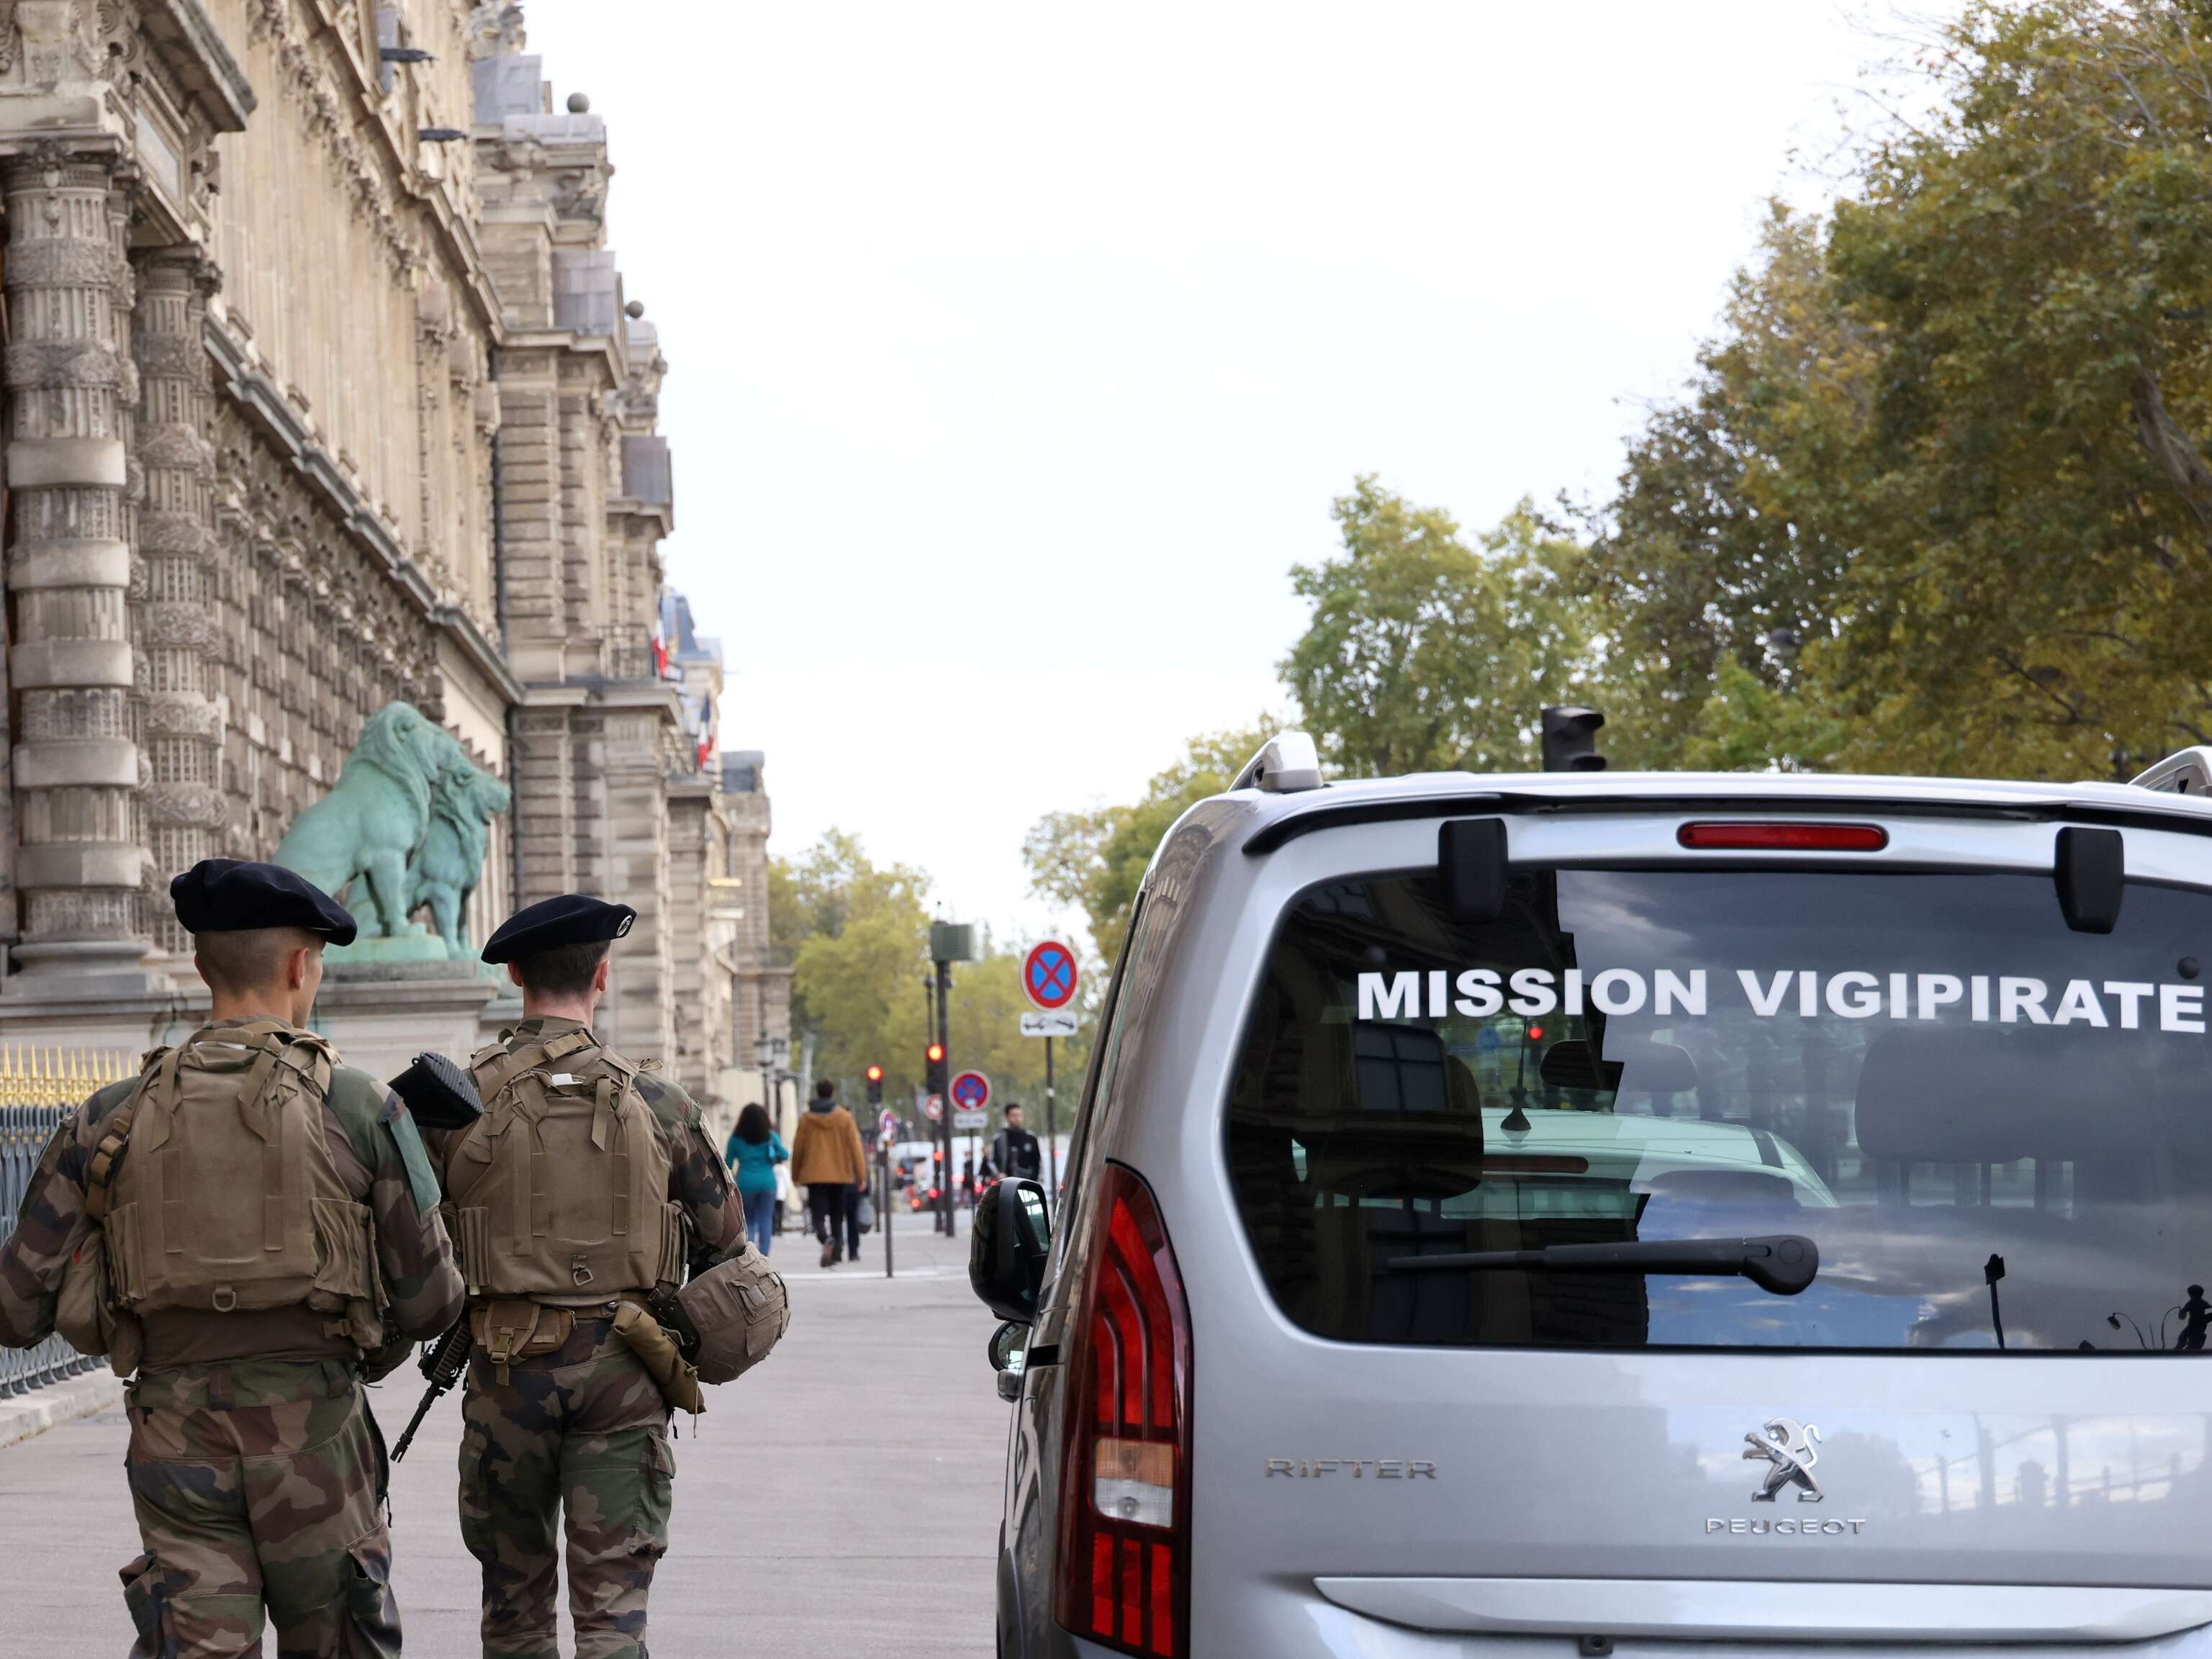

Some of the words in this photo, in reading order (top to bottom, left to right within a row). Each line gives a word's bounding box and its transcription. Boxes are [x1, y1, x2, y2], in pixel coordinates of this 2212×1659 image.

[1358, 968, 1707, 1020] MISSION
[1736, 969, 2206, 1033] VIGIPIRATE
[1265, 1458, 1437, 1479] RIFTER
[1705, 1518, 1866, 1534] PEUGEOT
